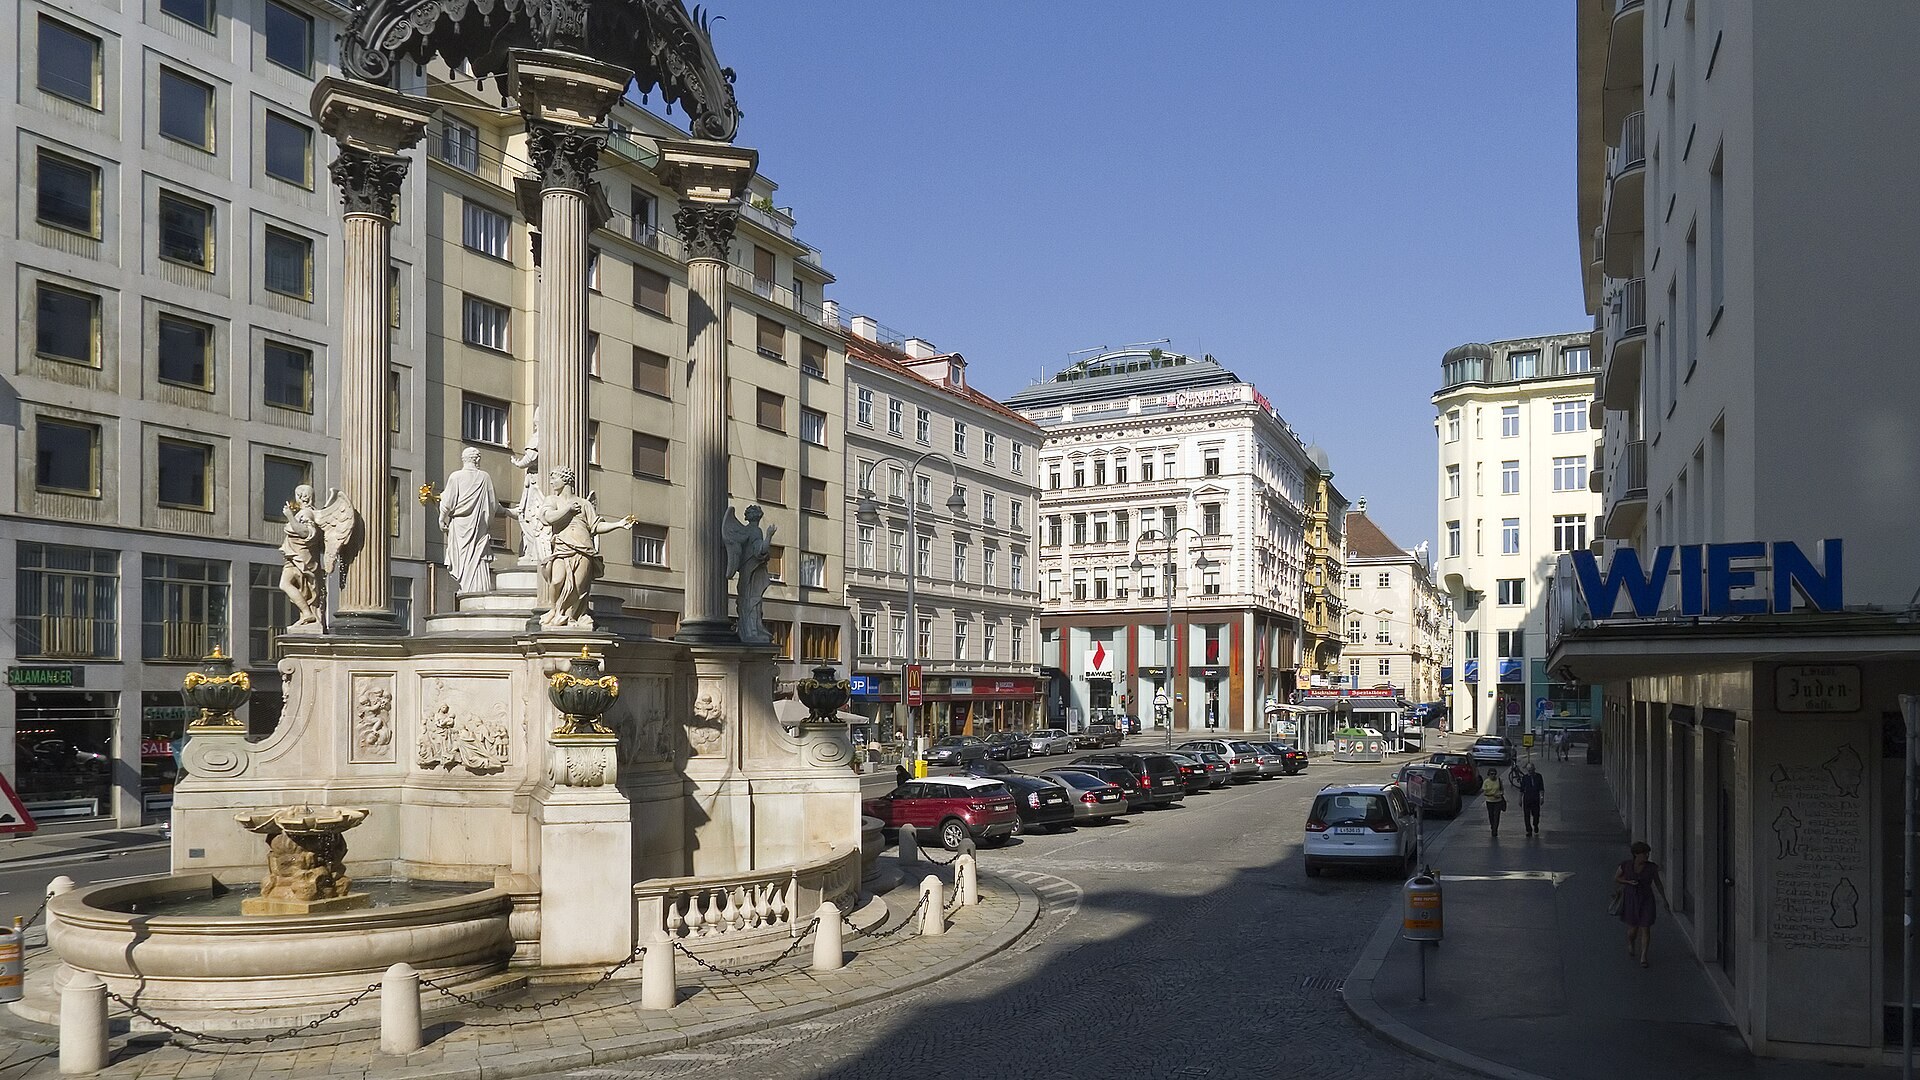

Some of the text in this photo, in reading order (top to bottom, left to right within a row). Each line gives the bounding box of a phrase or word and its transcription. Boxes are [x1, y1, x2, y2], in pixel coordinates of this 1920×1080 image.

[1570, 538, 1844, 620] WIEN
[9, 669, 72, 685] SALAMANDER
[142, 742, 173, 754] SALE
